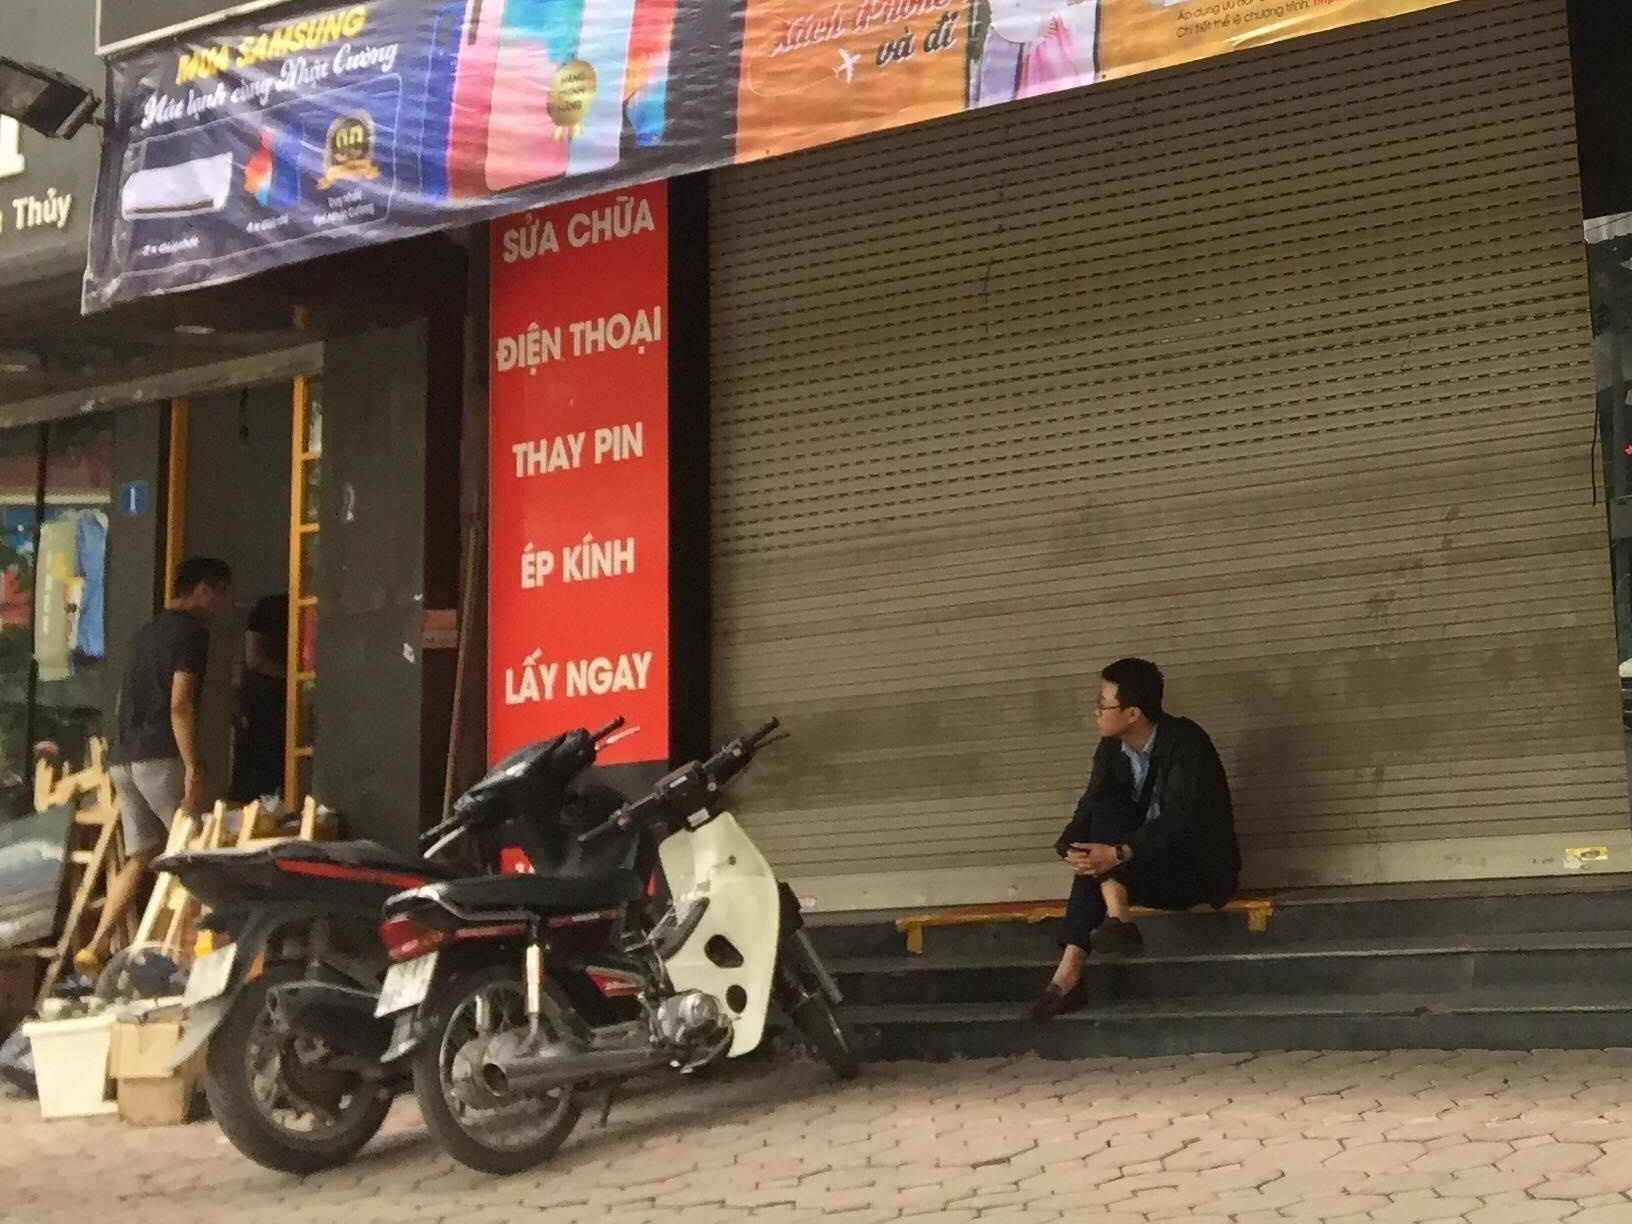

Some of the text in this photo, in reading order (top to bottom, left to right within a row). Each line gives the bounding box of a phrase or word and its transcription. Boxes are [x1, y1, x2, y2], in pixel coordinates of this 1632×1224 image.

[236, 5, 368, 68] SAMSUNG
[12, 187, 73, 230] Thủy
[502, 196, 656, 264] SỬA CHỮA
[496, 305, 662, 376] ĐIỆN THOẠI
[512, 422, 643, 478] THAY PIN
[521, 531, 635, 590] ÉP KÍNH
[504, 647, 653, 705] LẤY NGAY
